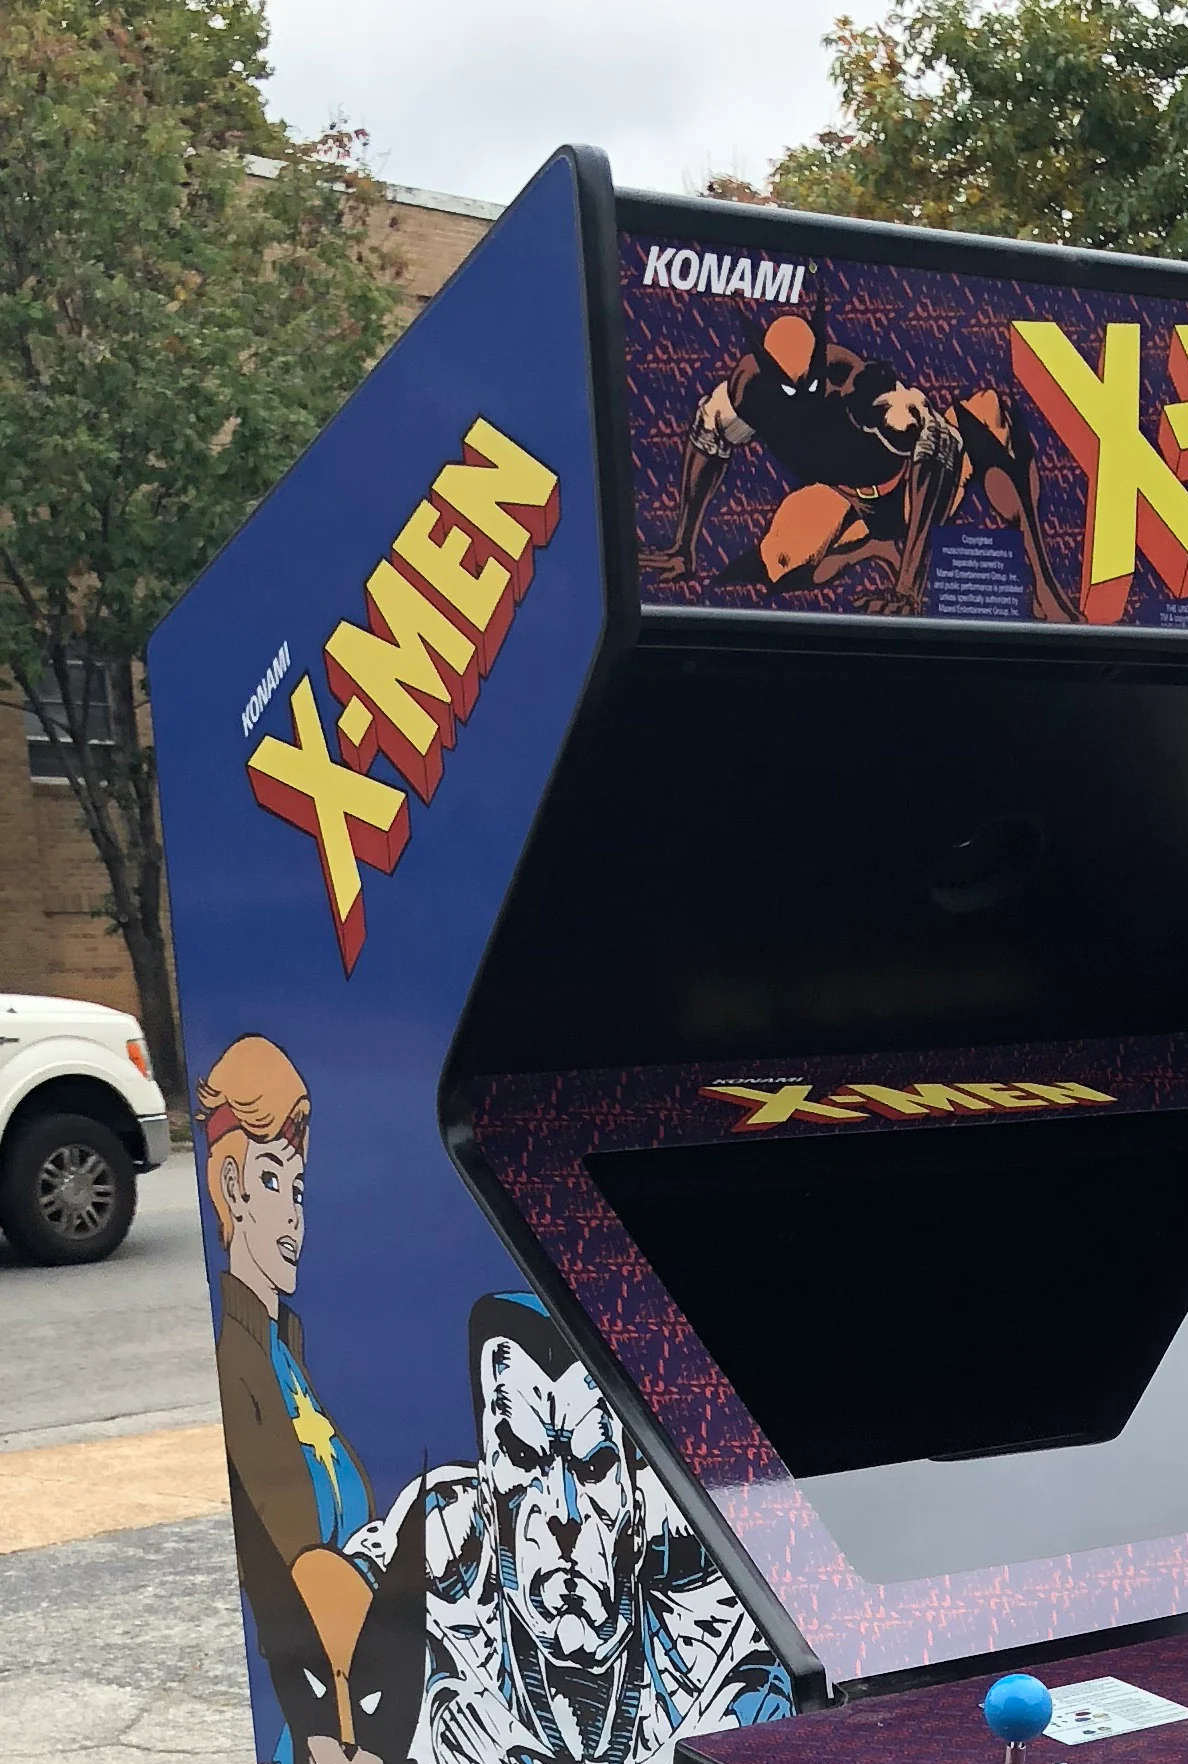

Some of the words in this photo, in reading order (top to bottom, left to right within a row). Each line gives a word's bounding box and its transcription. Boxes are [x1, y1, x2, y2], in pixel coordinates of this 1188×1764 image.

[642, 244, 805, 304] KONAMI
[241, 640, 291, 738] KONAMI
[245, 412, 562, 982] X-MEN
[697, 1081, 1119, 1133] X-MEN
[712, 1076, 804, 1085] KONAMI
